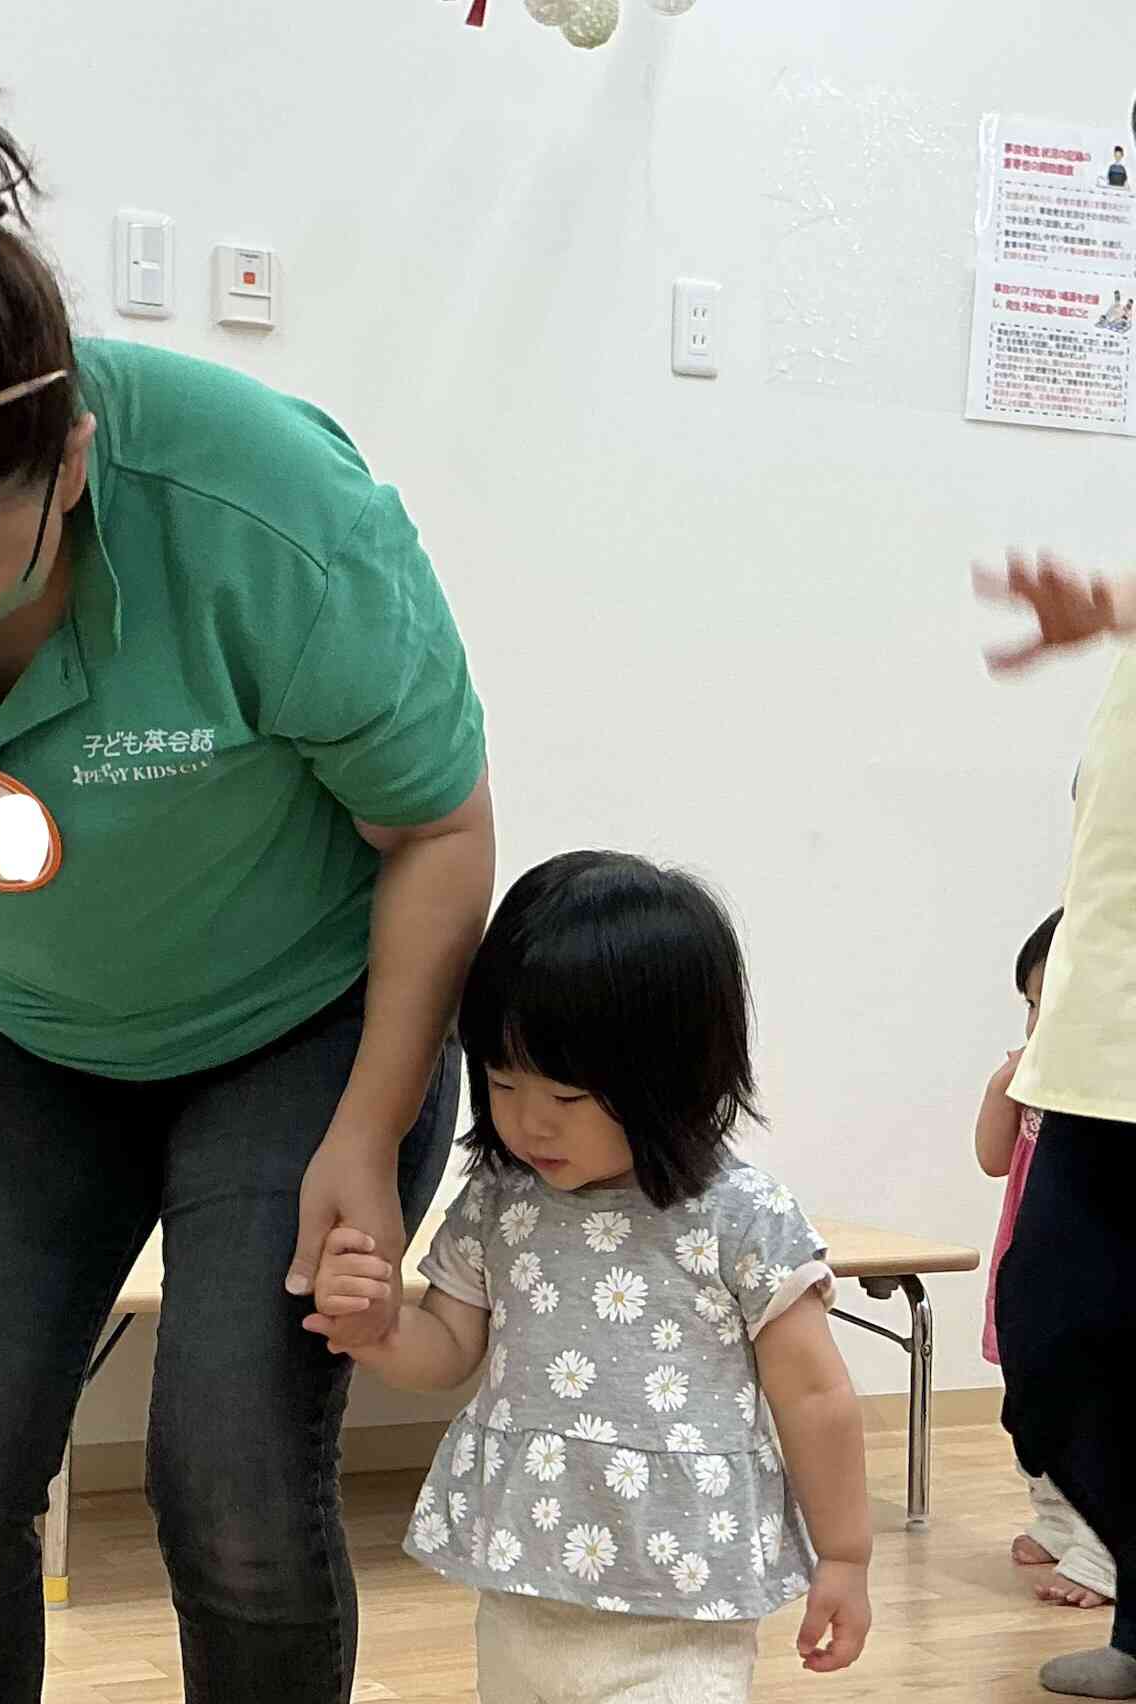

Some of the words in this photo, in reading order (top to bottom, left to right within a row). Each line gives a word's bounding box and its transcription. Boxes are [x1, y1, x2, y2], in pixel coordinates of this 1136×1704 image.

[82, 728, 215, 758] 子ども英会話
[133, 764, 177, 782] KIDS
